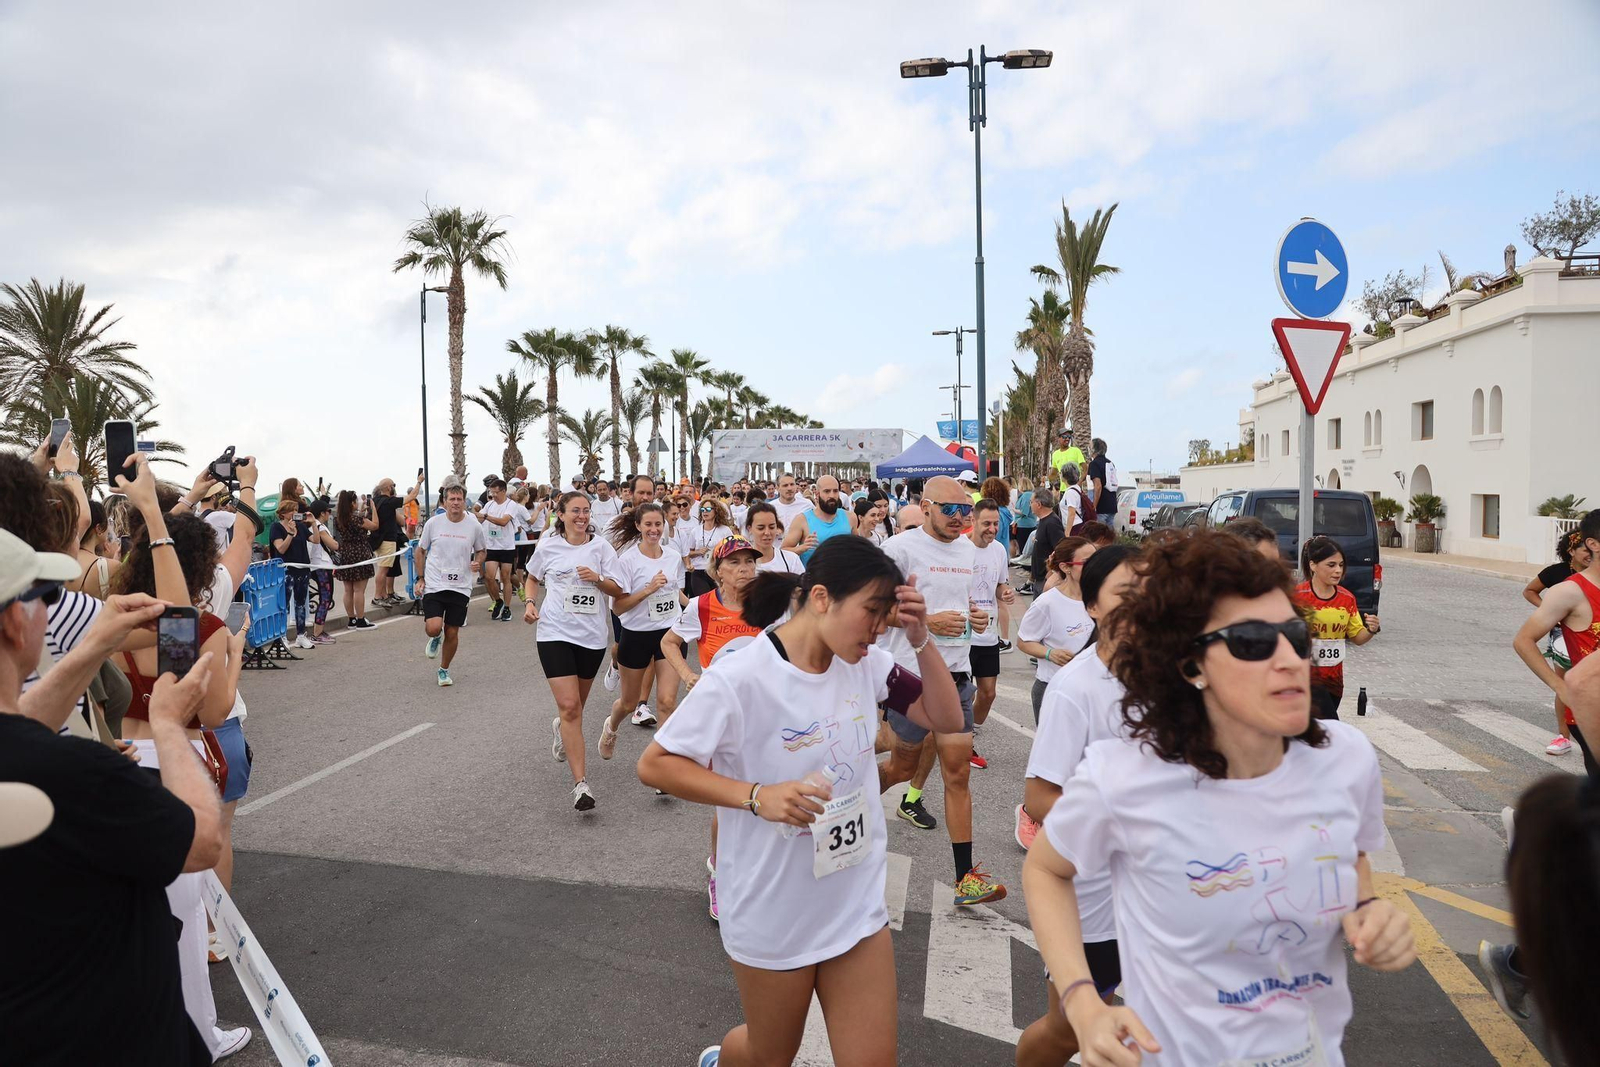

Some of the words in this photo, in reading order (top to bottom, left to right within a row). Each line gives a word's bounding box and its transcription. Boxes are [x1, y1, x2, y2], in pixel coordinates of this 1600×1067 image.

[572, 595, 595, 606] 529
[656, 600, 675, 613] 528
[1318, 648, 1340, 659] 838
[828, 812, 864, 851] 331
